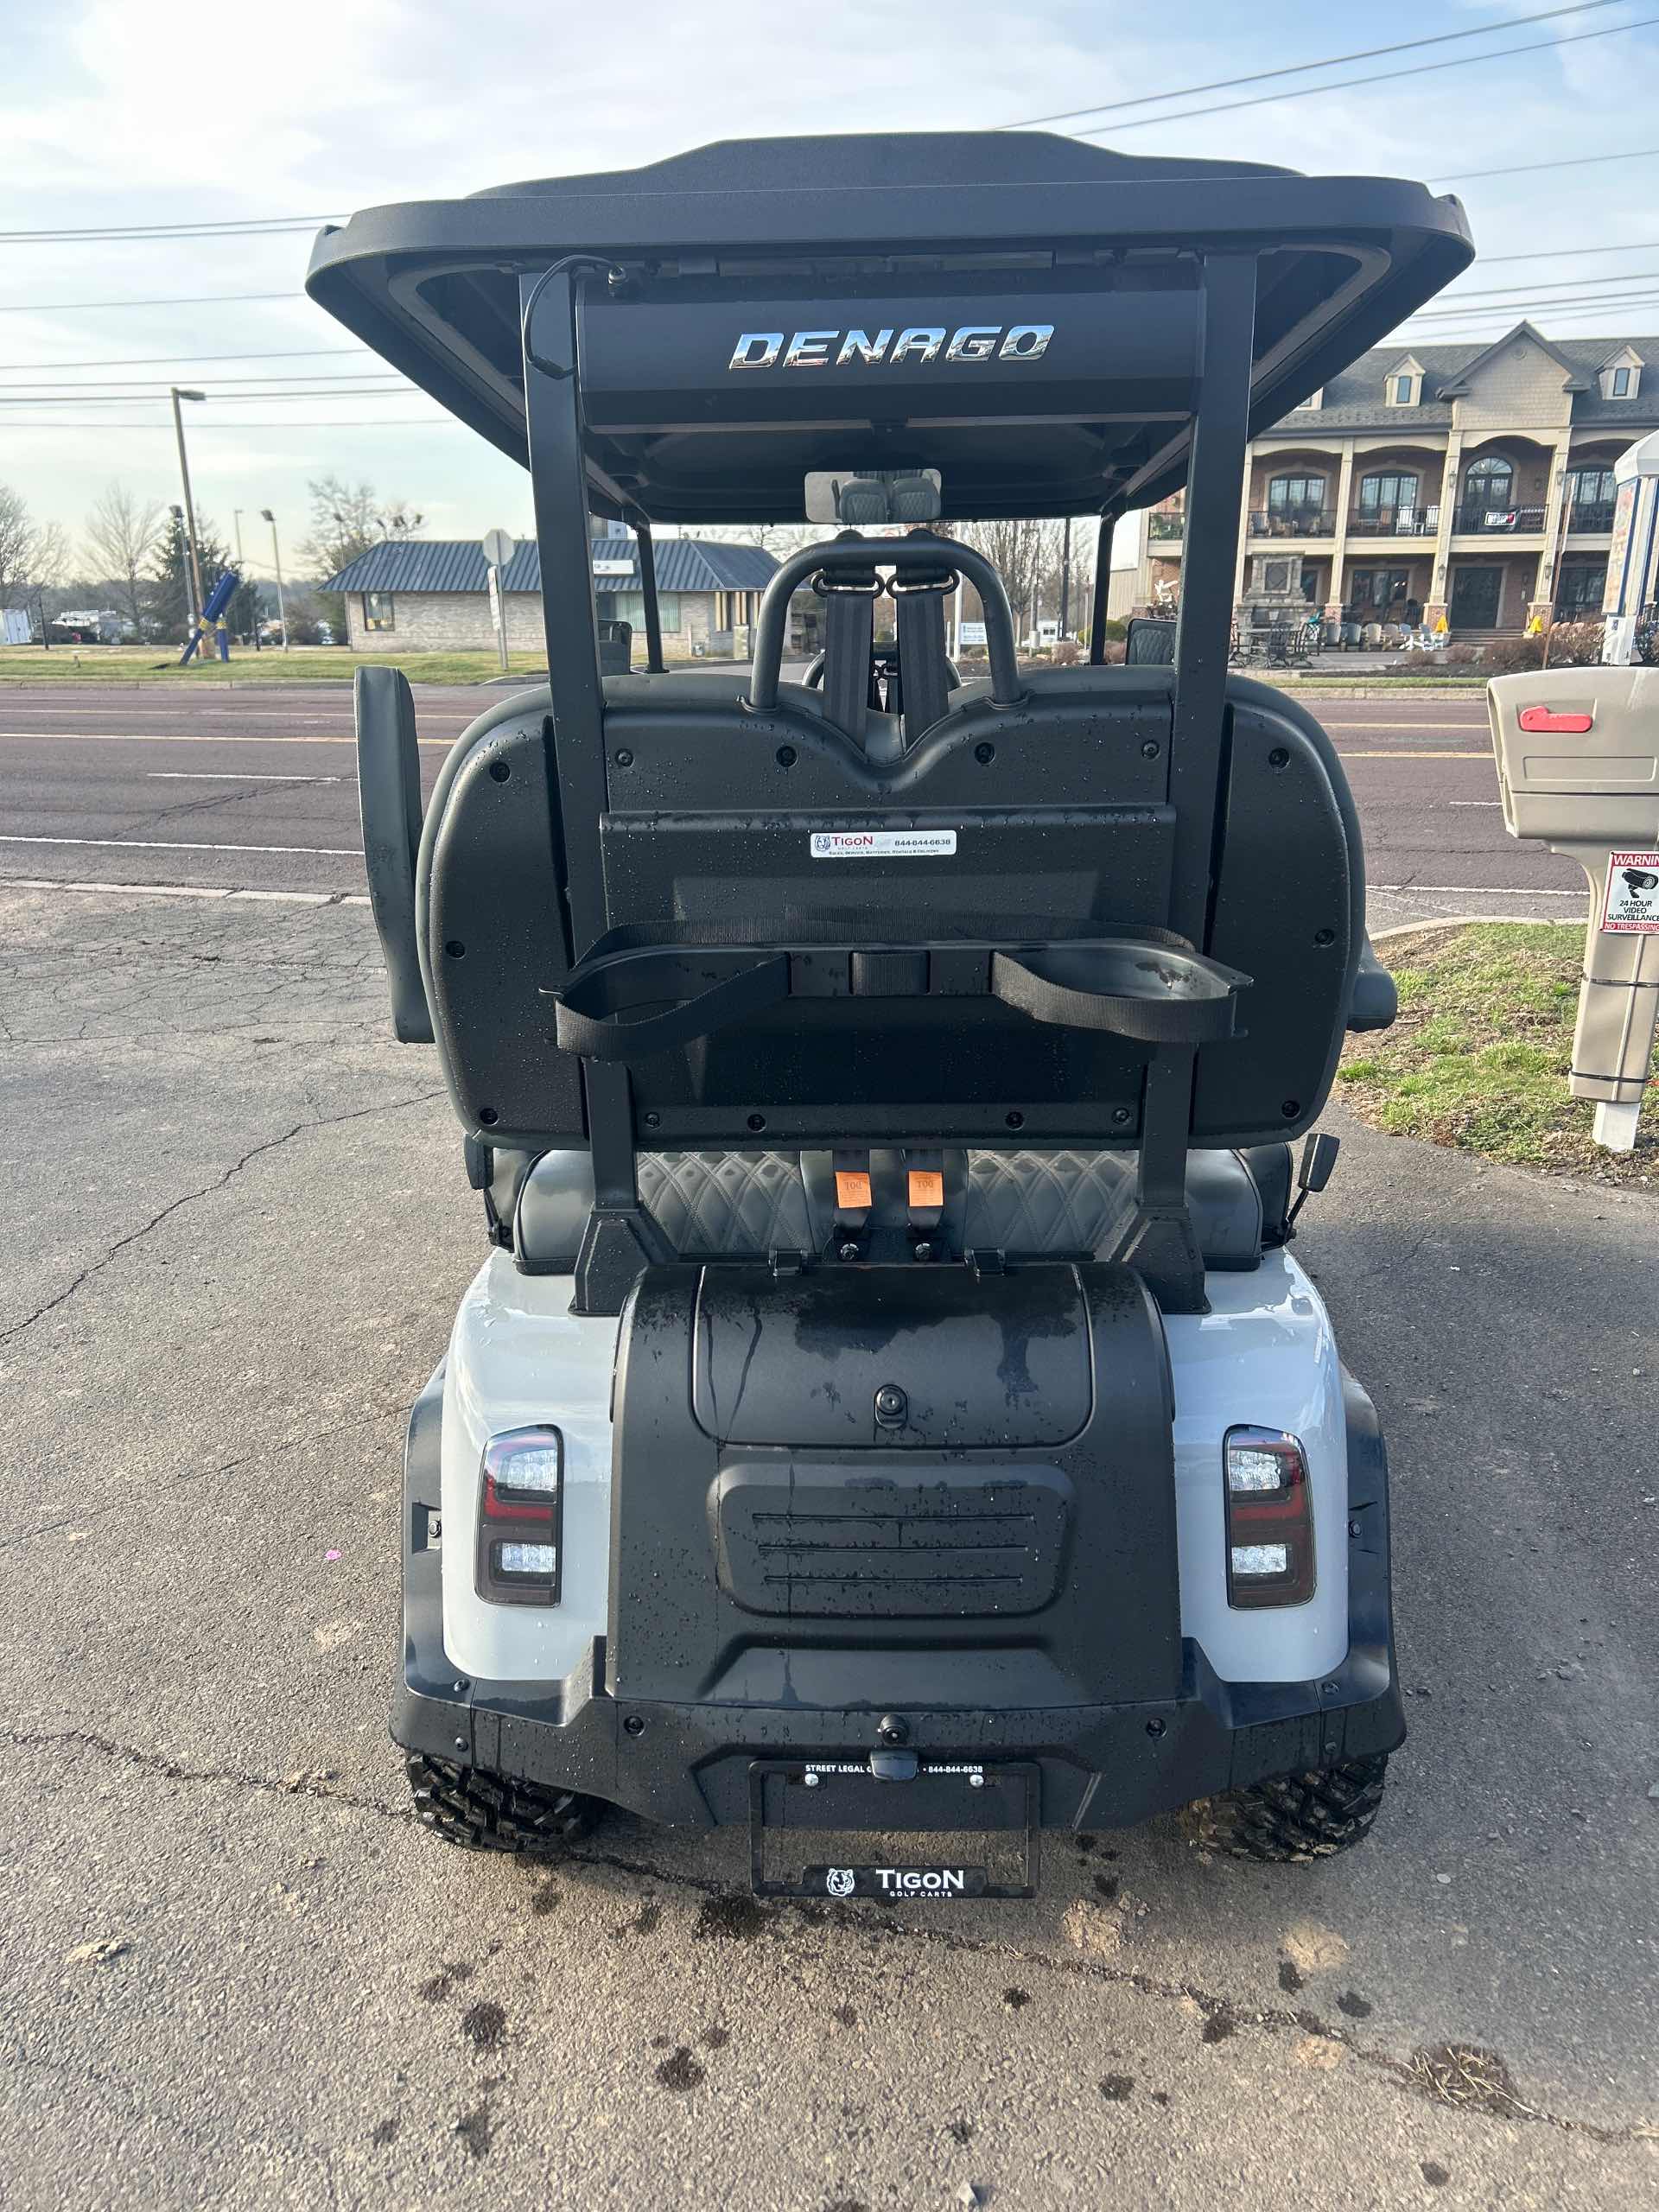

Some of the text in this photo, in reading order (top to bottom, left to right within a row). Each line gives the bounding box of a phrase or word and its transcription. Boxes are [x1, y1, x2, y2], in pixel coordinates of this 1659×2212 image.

[729, 325, 1055, 370] DENAGO
[831, 836, 874, 846] TIGON
[875, 1868, 965, 1889] TIGON
